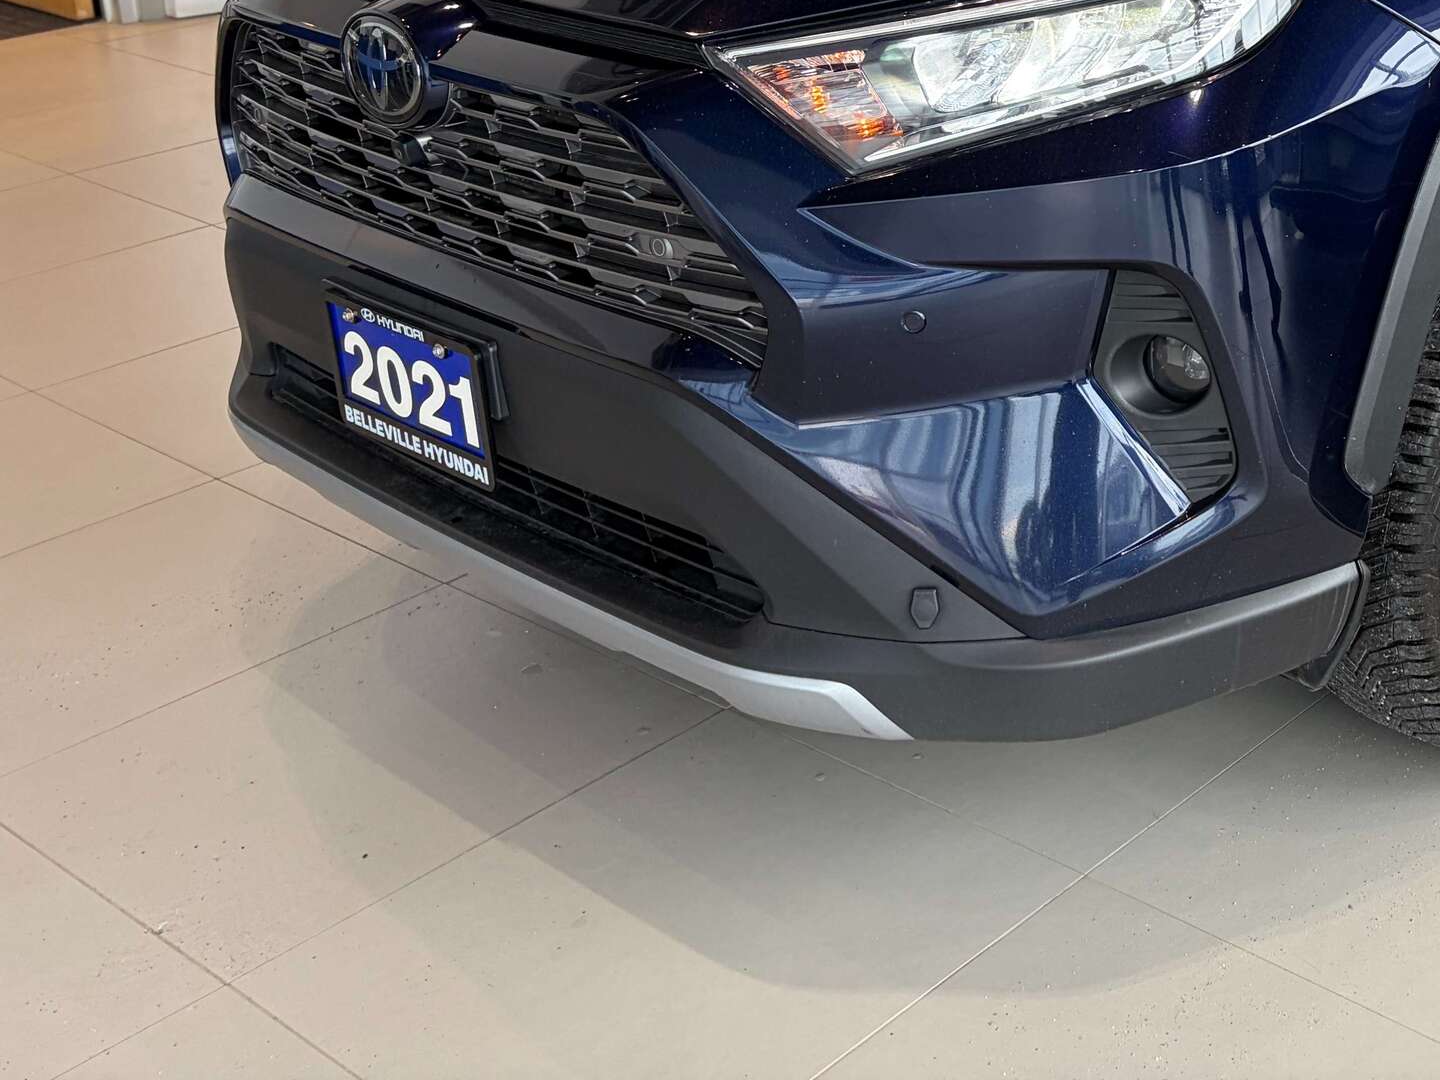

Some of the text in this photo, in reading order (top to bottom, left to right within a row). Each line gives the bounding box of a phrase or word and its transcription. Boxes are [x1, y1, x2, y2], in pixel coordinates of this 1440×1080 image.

[376, 314, 425, 342] HYUNDAI
[343, 331, 480, 449] 2021
[344, 404, 490, 486] BELLEVILLE HYUNDAI
